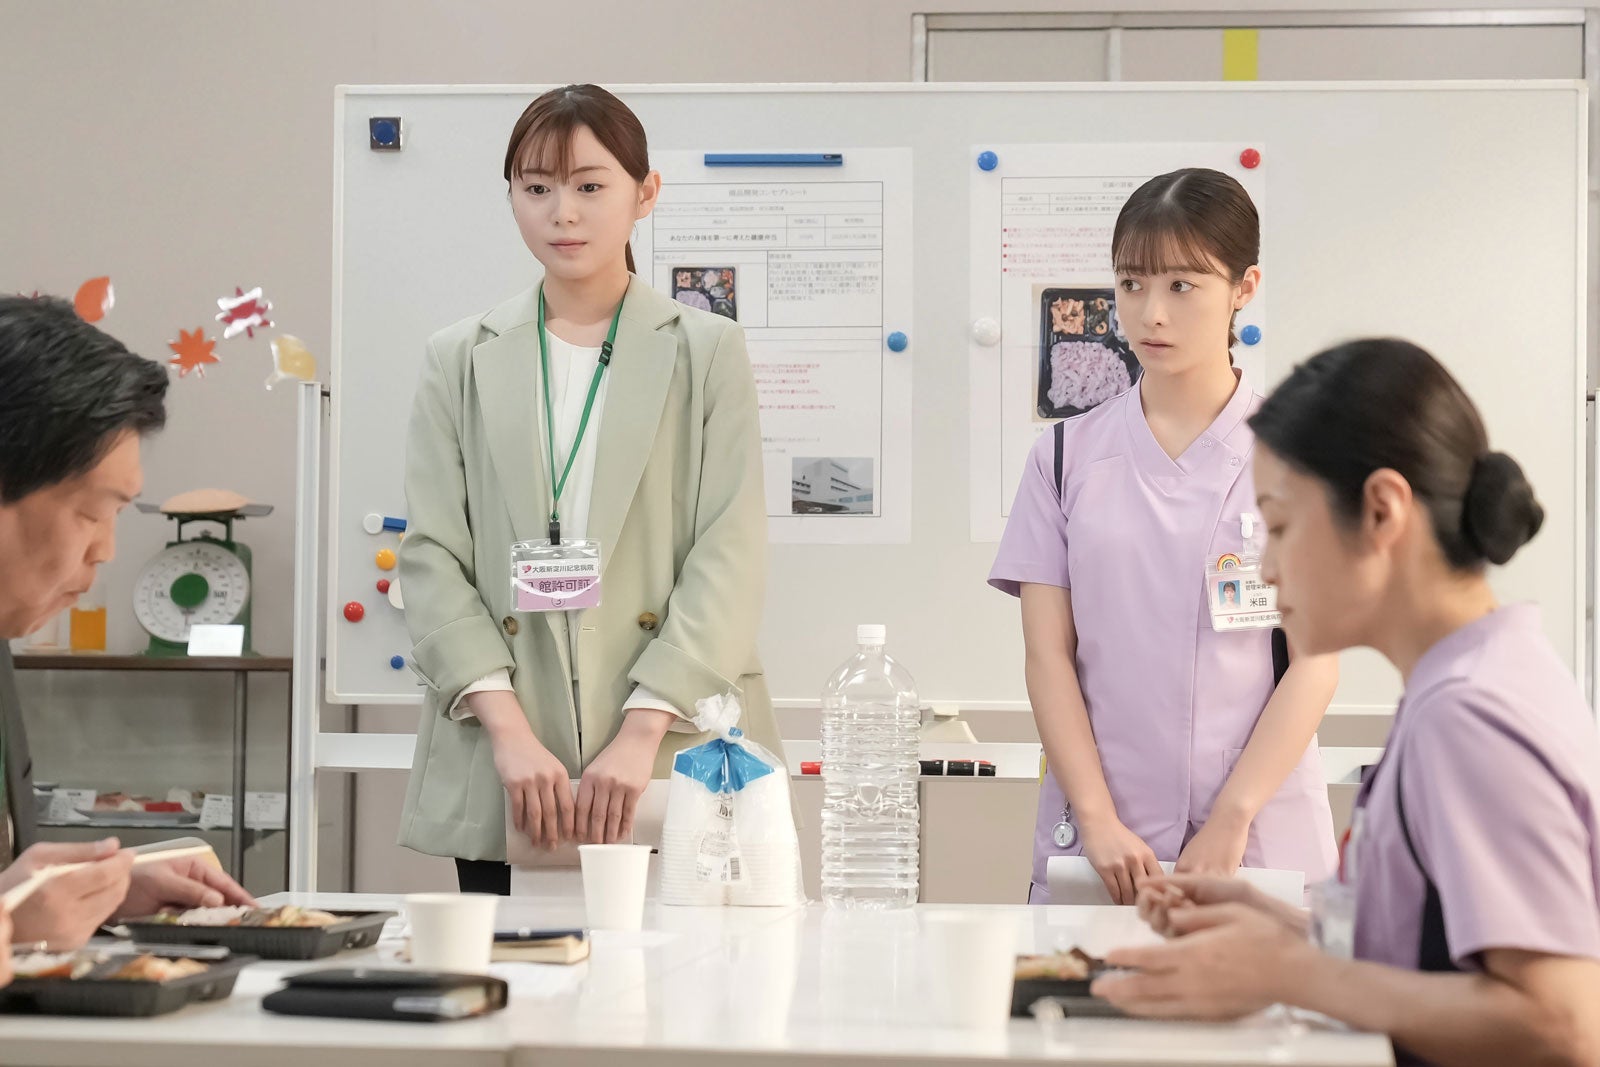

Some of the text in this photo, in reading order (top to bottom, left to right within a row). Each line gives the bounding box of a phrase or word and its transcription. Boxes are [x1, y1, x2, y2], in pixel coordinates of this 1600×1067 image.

[669, 233, 778, 242] あなたの身体を第一に考えた健康弁当
[532, 564, 594, 573] 大阪新淀川記念病院
[1249, 597, 1267, 607] 米田
